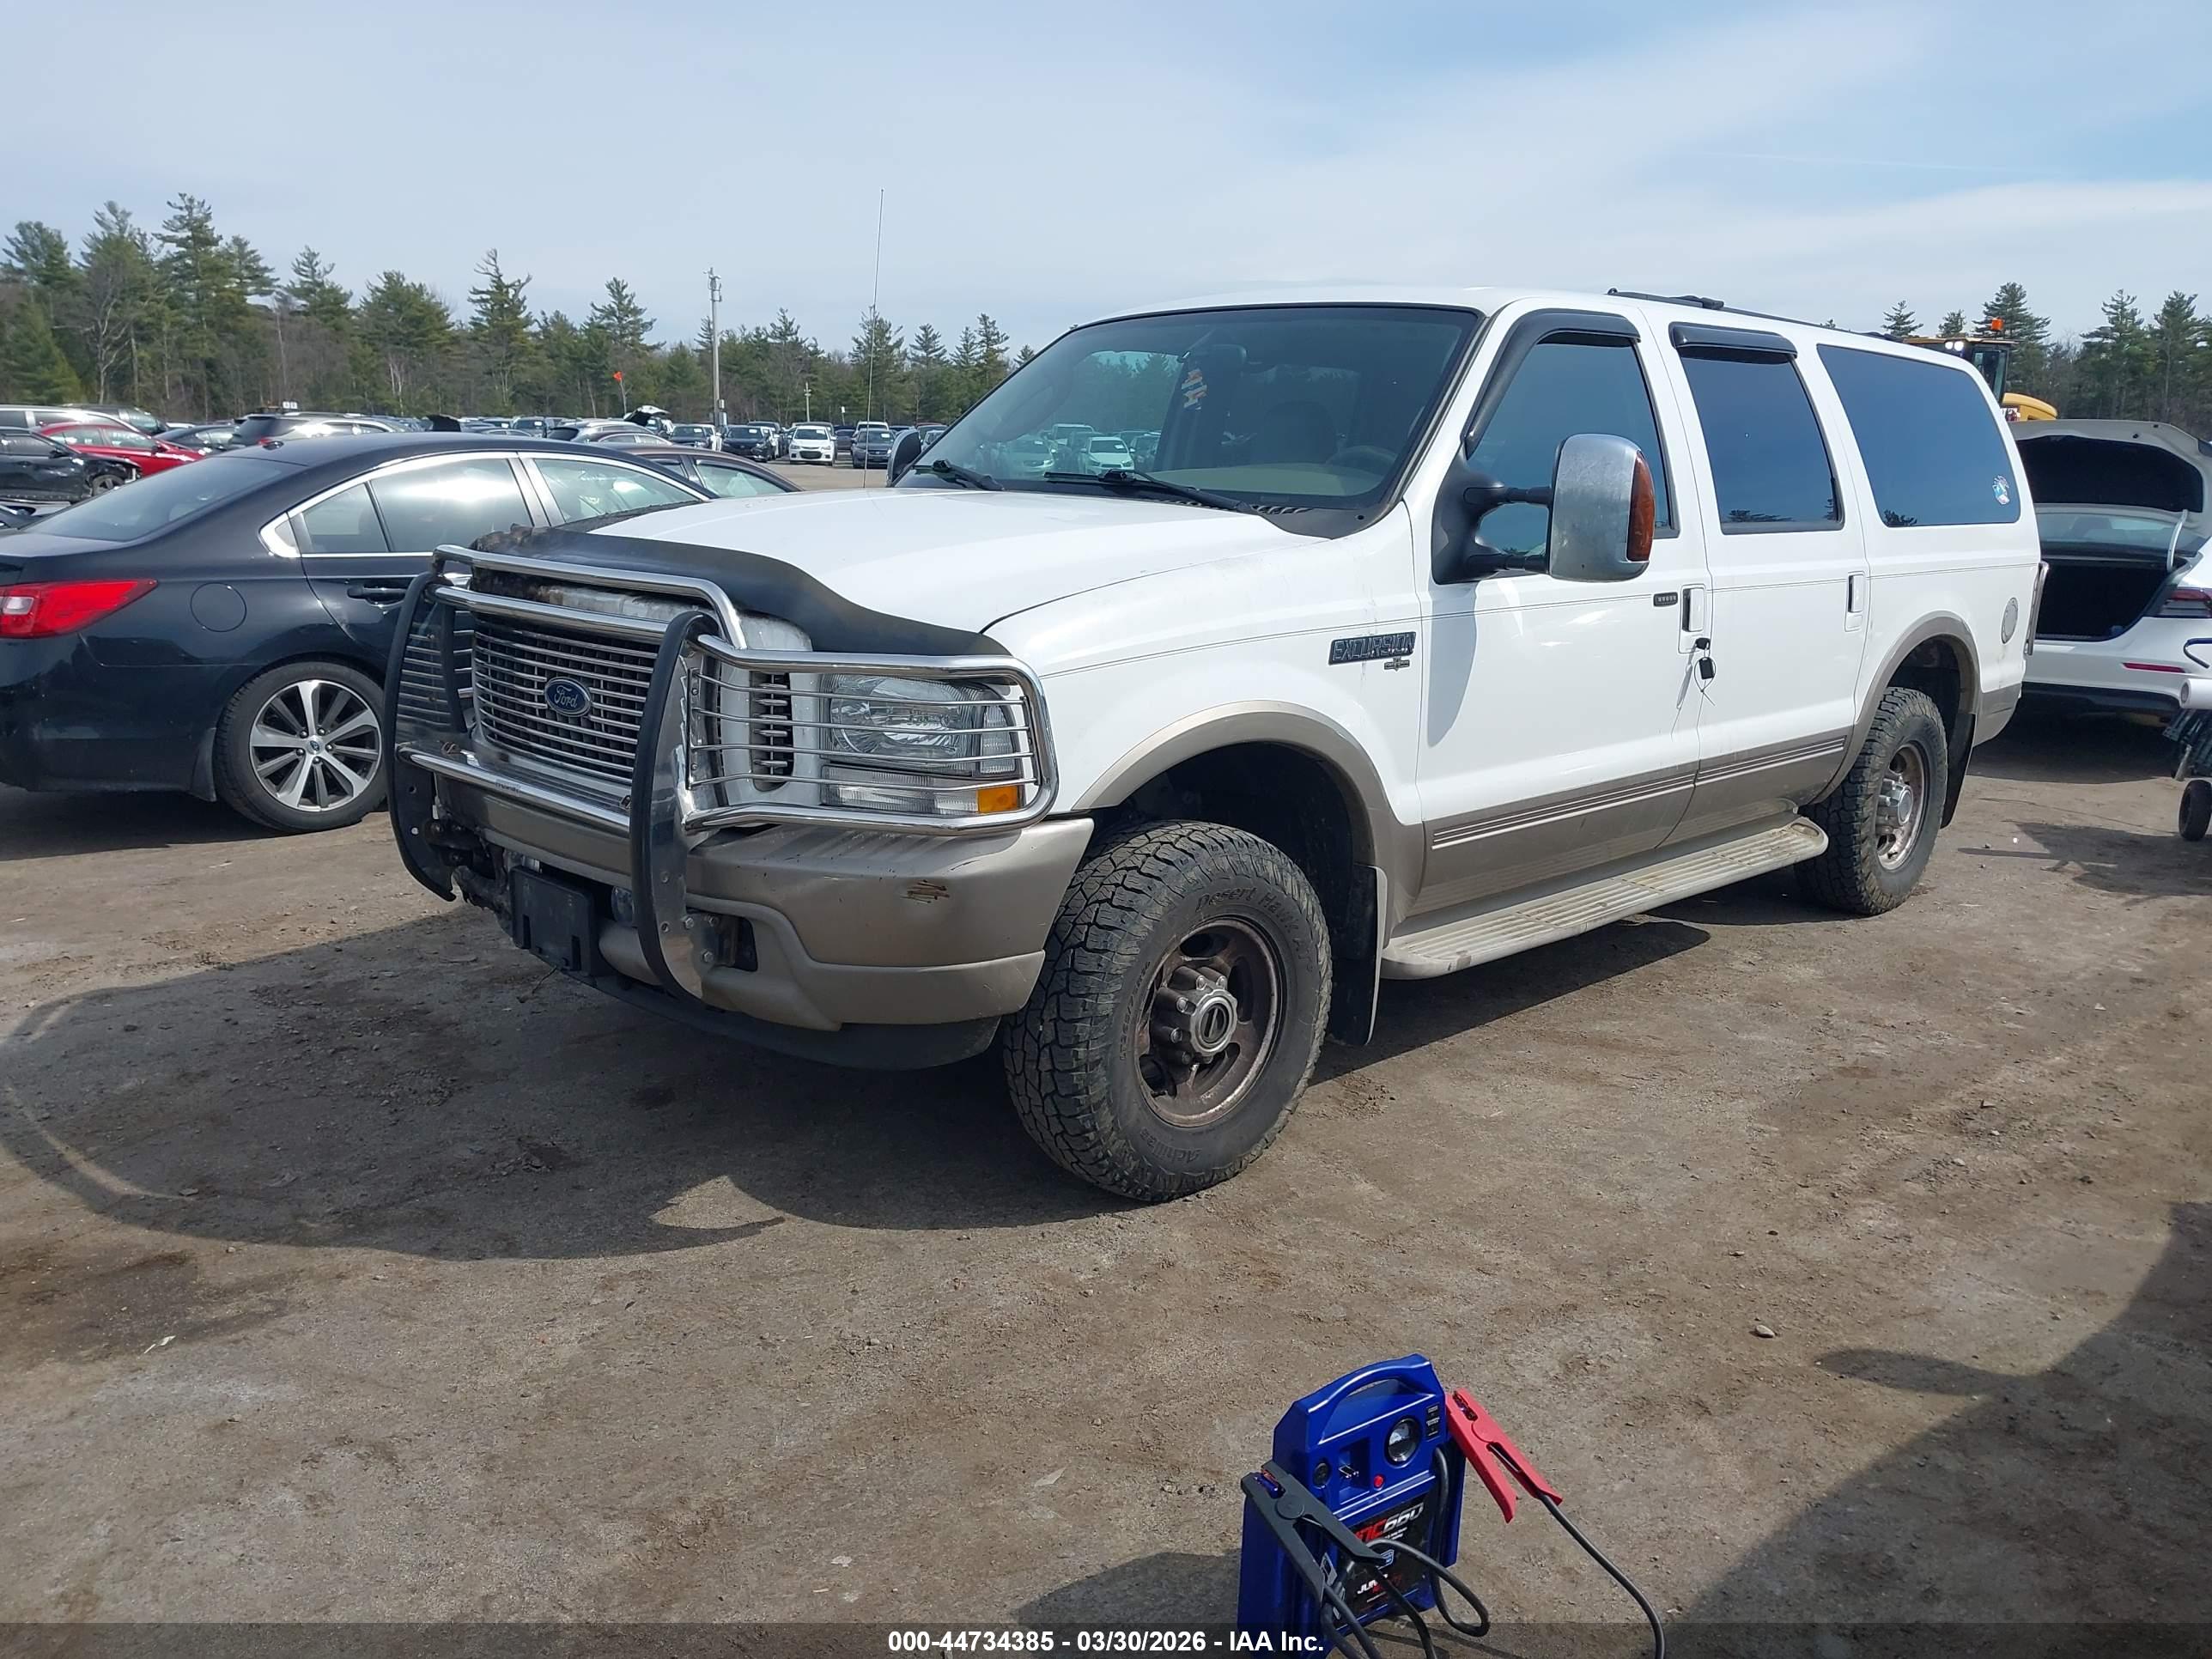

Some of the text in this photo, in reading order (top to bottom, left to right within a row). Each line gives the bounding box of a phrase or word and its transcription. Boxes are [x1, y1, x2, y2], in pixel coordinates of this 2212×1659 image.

[1332, 633, 1415, 662] EXCURSION
[554, 684, 579, 708] Ford
[1194, 887, 1257, 912] Desert
